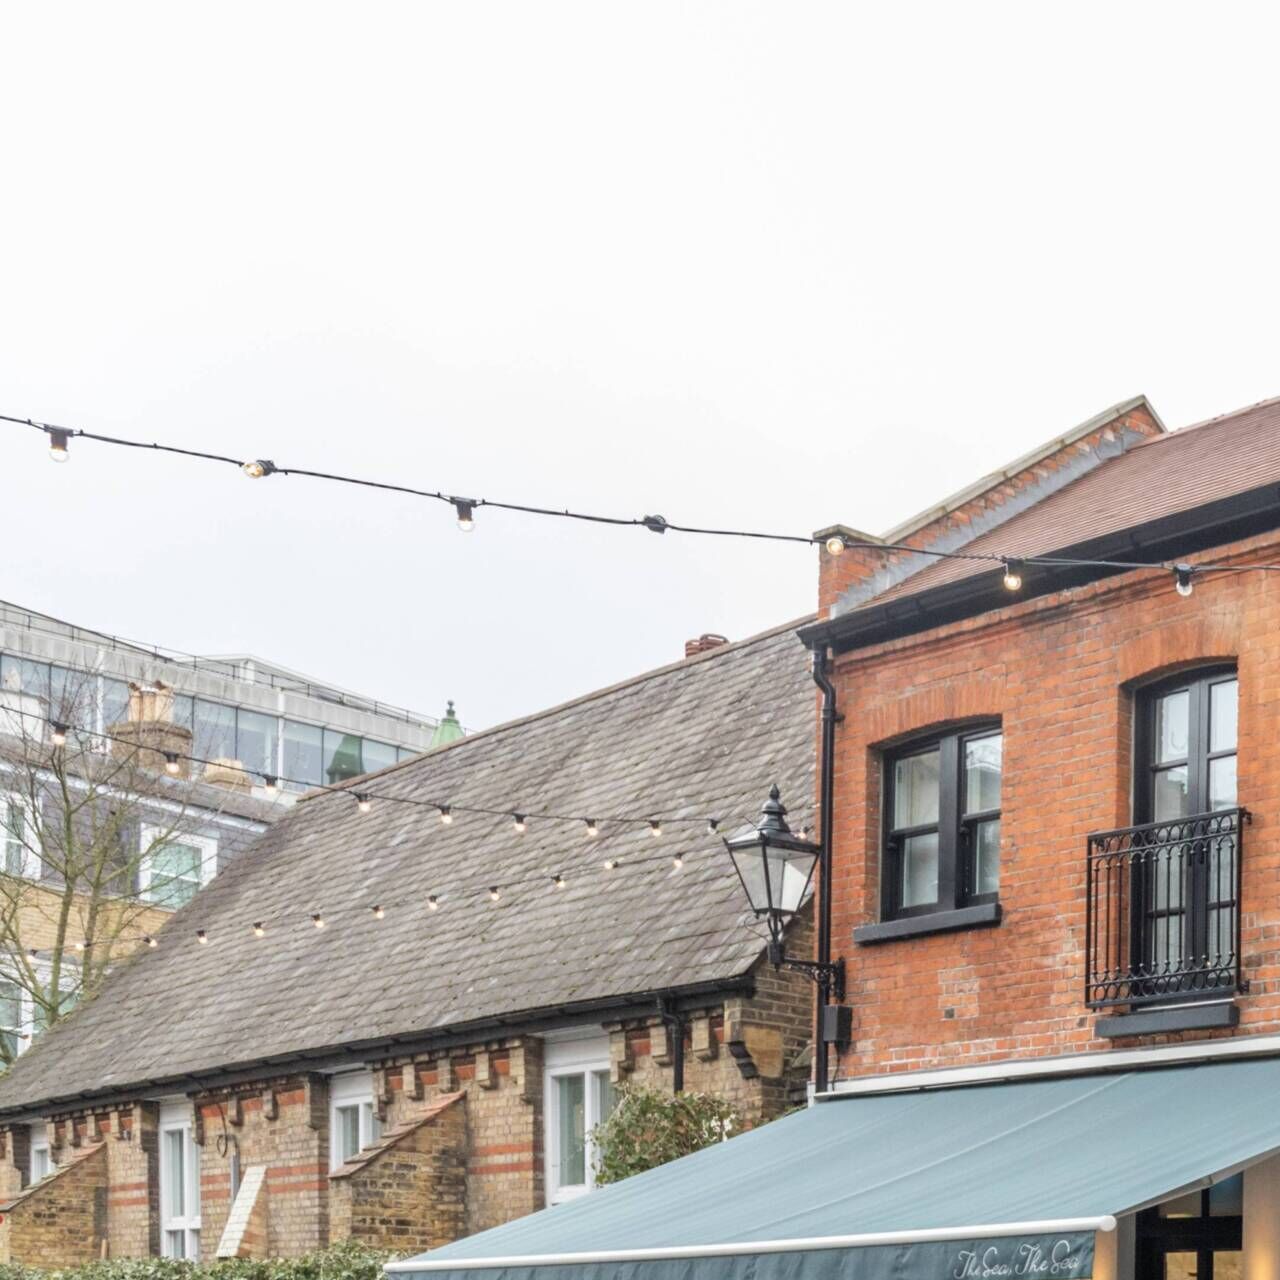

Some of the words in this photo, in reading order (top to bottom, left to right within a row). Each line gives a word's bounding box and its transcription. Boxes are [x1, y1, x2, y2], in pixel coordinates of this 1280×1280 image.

[953, 1250, 981, 1279] The
[1015, 1243, 1048, 1275] The
[1050, 1239, 1080, 1274] Sea
